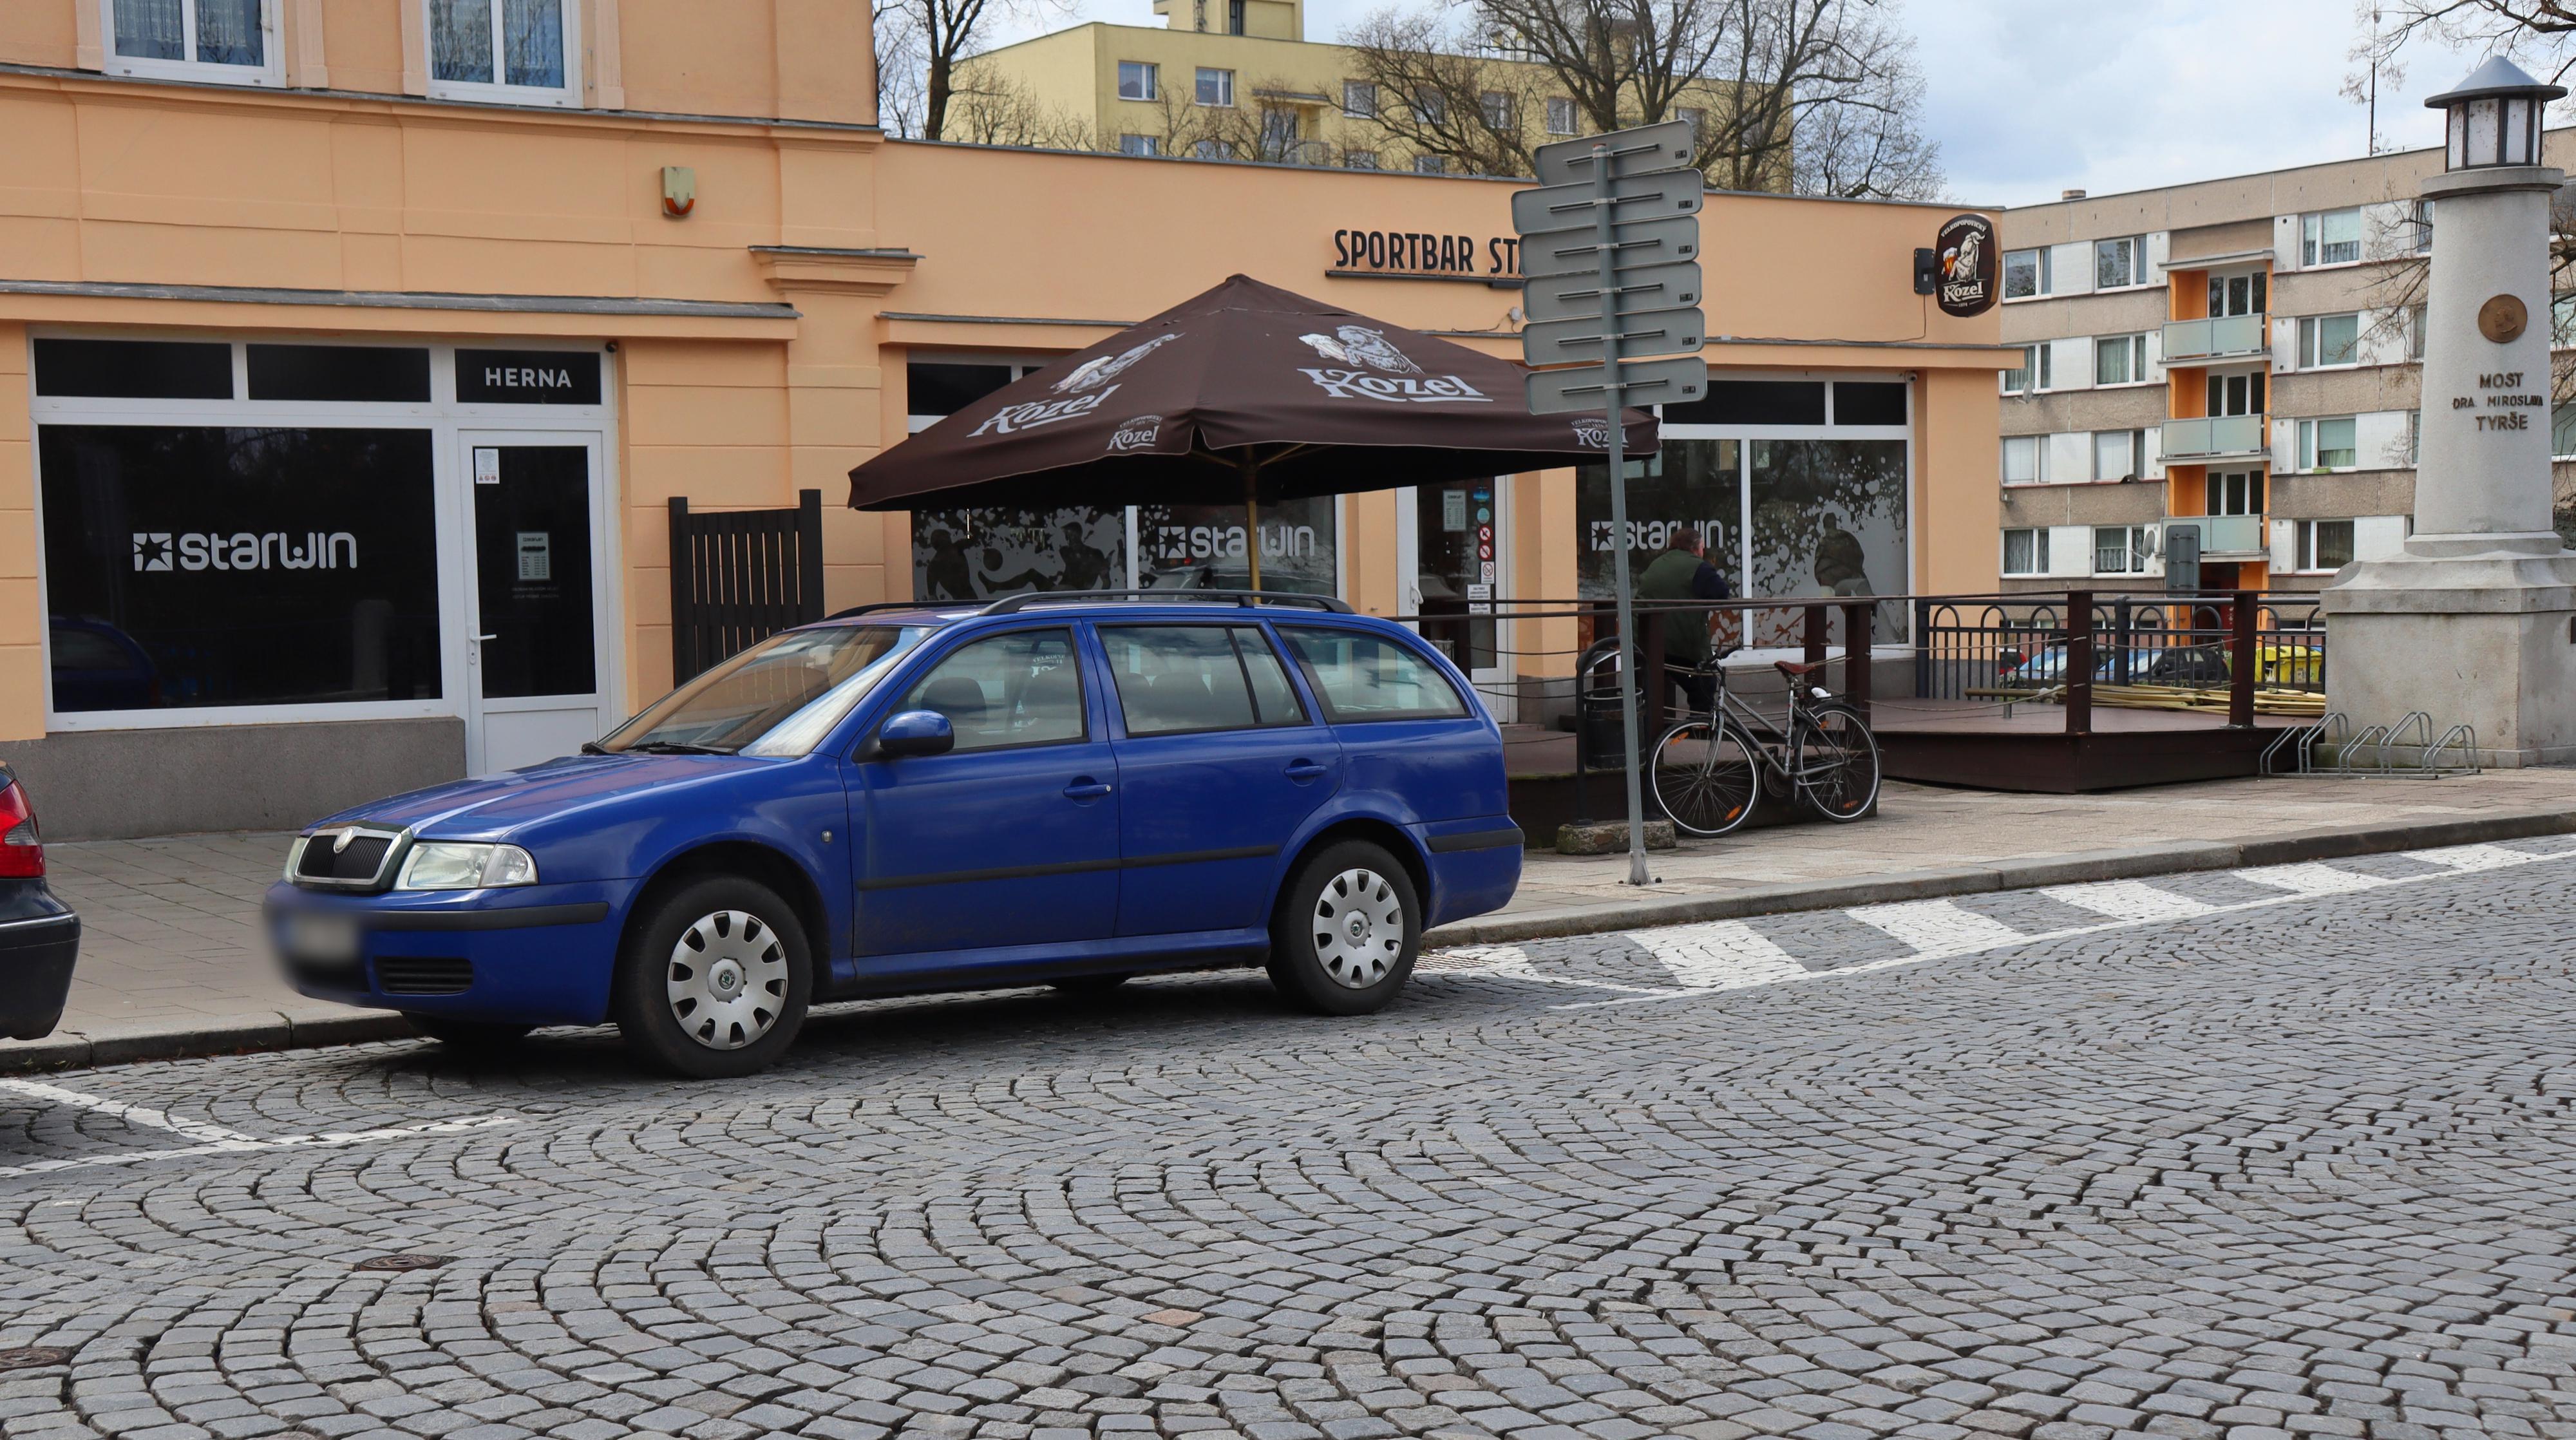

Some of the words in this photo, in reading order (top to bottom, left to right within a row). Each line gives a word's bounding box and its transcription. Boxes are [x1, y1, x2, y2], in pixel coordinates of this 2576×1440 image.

[1334, 229, 1473, 272] SPORTBAR
[1489, 237, 1520, 274] ST
[1944, 281, 1983, 302] Kozel
[486, 367, 572, 388] HERNA
[1297, 368, 1489, 403] Kozel
[2479, 372, 2524, 388] MOST
[966, 383, 1122, 438] Kozel
[2476, 411, 2528, 431] TYRŠE
[1106, 425, 1160, 450] Kozel
[1573, 428, 1629, 448] Kozl
[179, 532, 357, 571] starwin
[1191, 526, 1315, 558] stawin
